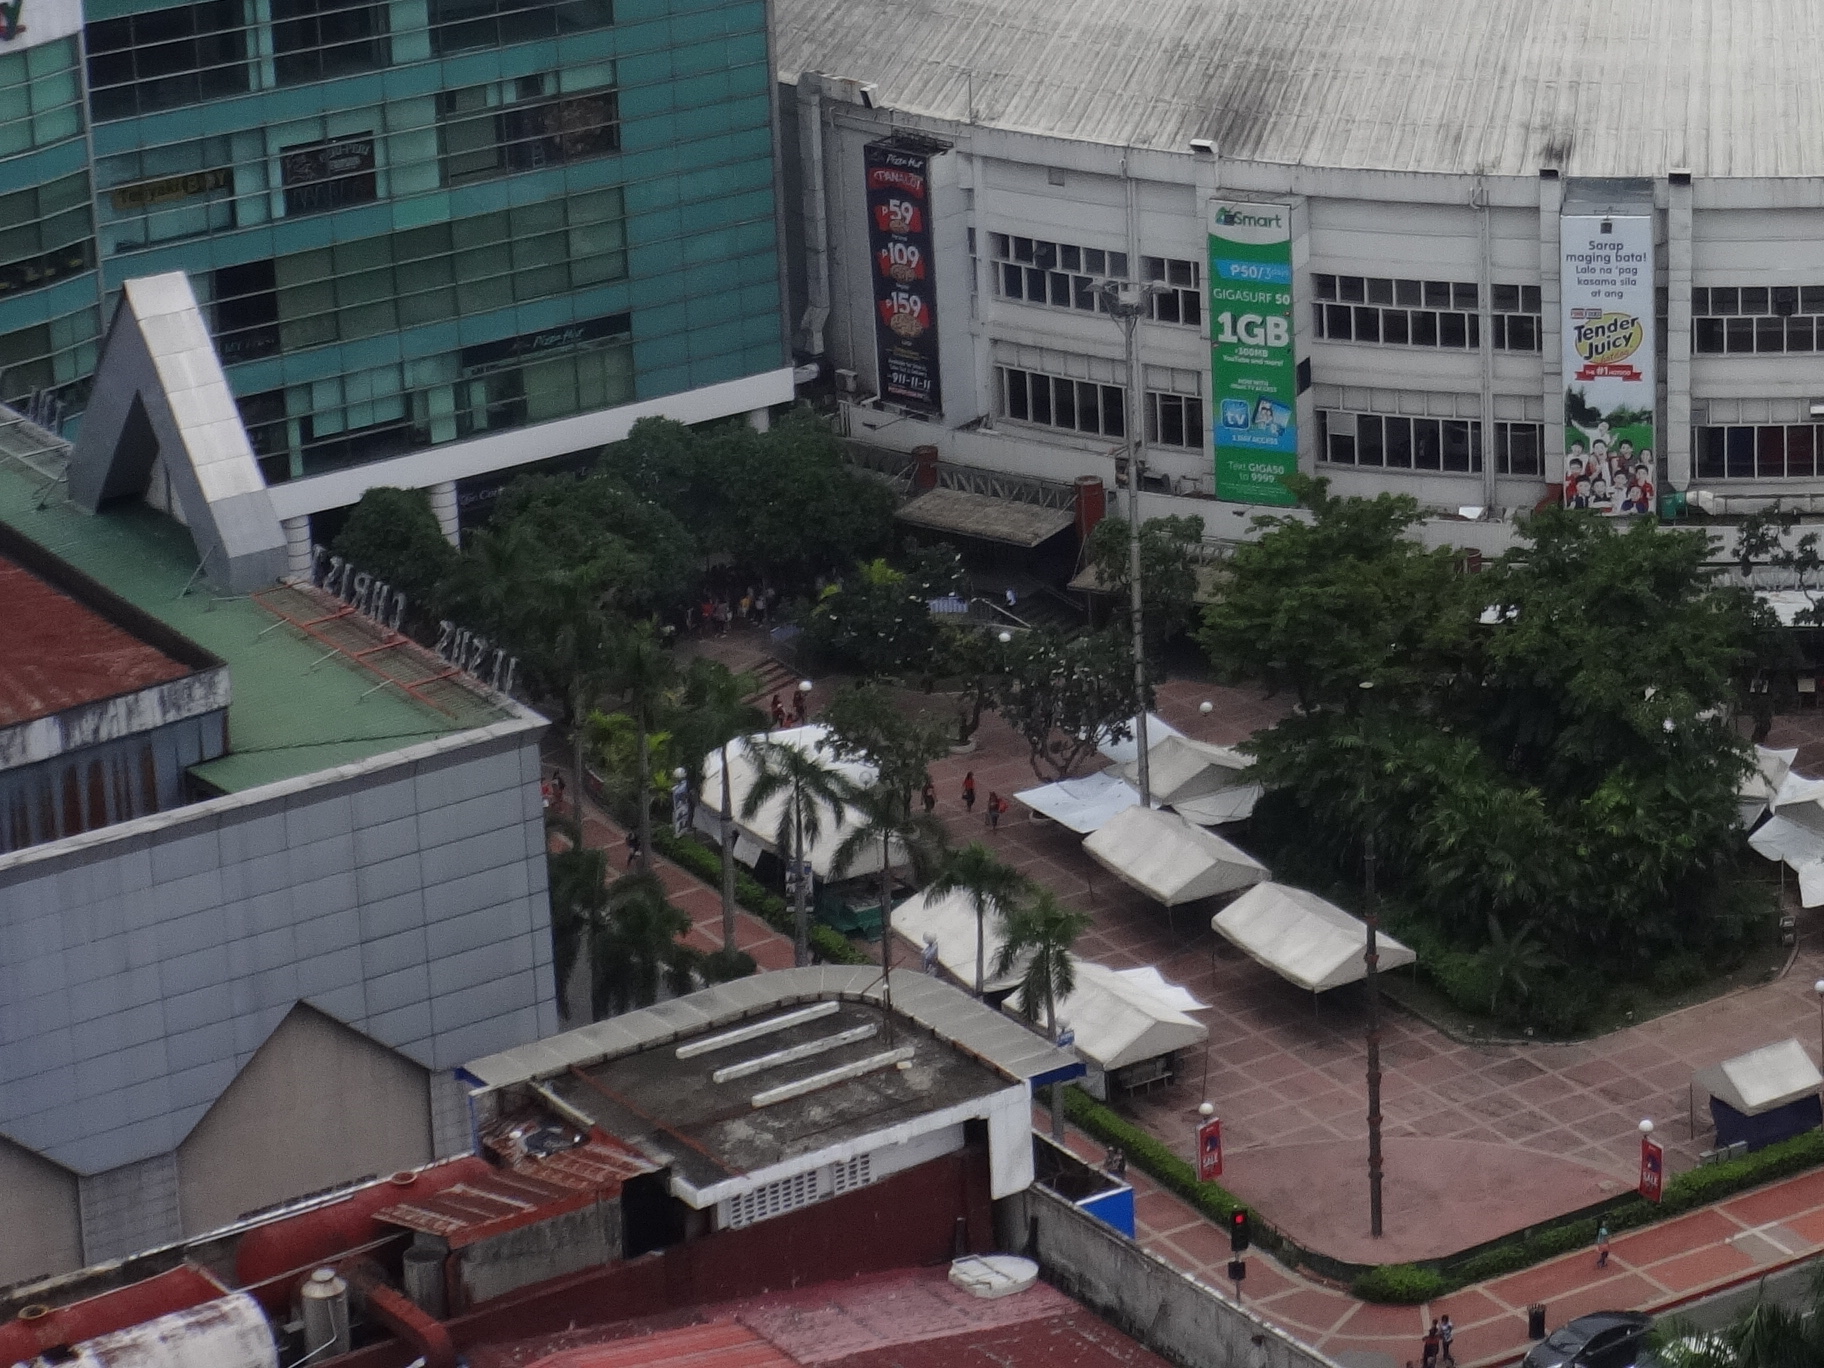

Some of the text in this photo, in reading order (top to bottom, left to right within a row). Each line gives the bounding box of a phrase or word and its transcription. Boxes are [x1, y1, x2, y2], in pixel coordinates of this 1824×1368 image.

[1234, 211, 1282, 228] Smart
[1588, 240, 1624, 253] Sarap
[1566, 252, 1647, 264] maging bata!
[1575, 265, 1596, 274] Lalo
[1577, 277, 1637, 286] kasama sila
[1213, 288, 1290, 305] GIGASURF 50
[1590, 289, 1624, 300] at ang
[1218, 311, 1290, 347] 1GB
[1573, 317, 1639, 343] Tender
[1584, 332, 1633, 360] Juicy
[1596, 366, 1608, 375] #1
[892, 372, 932, 390] 911-11-11
[1227, 460, 1285, 475] Text GIGA50
